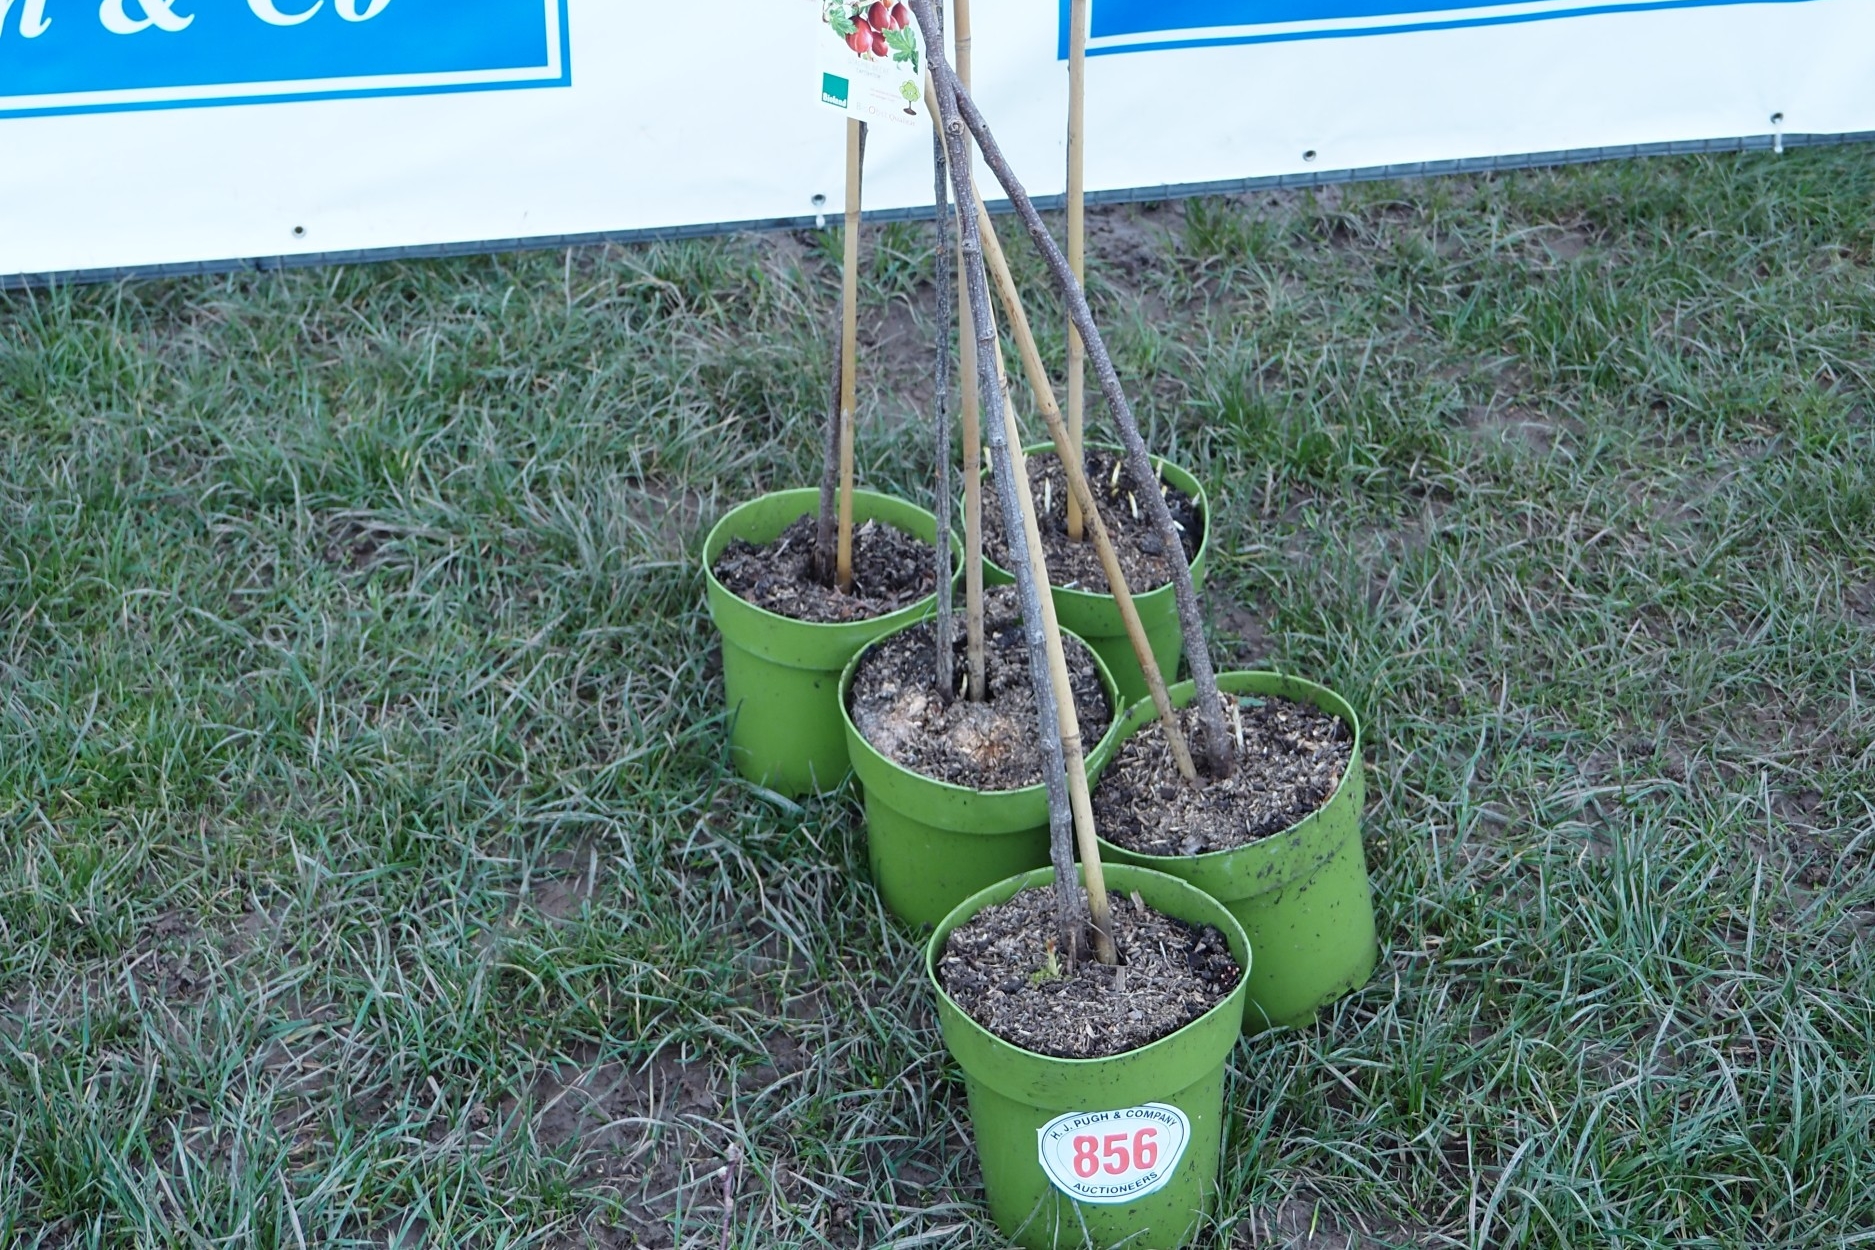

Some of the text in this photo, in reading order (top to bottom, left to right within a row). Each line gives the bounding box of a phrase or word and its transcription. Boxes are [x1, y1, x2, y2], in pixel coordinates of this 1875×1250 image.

[1050, 1109, 1177, 1140] H. J. PUGH & COMPANY
[1073, 1127, 1158, 1178] 856
[1073, 1171, 1158, 1194] AUCTIONEERS
